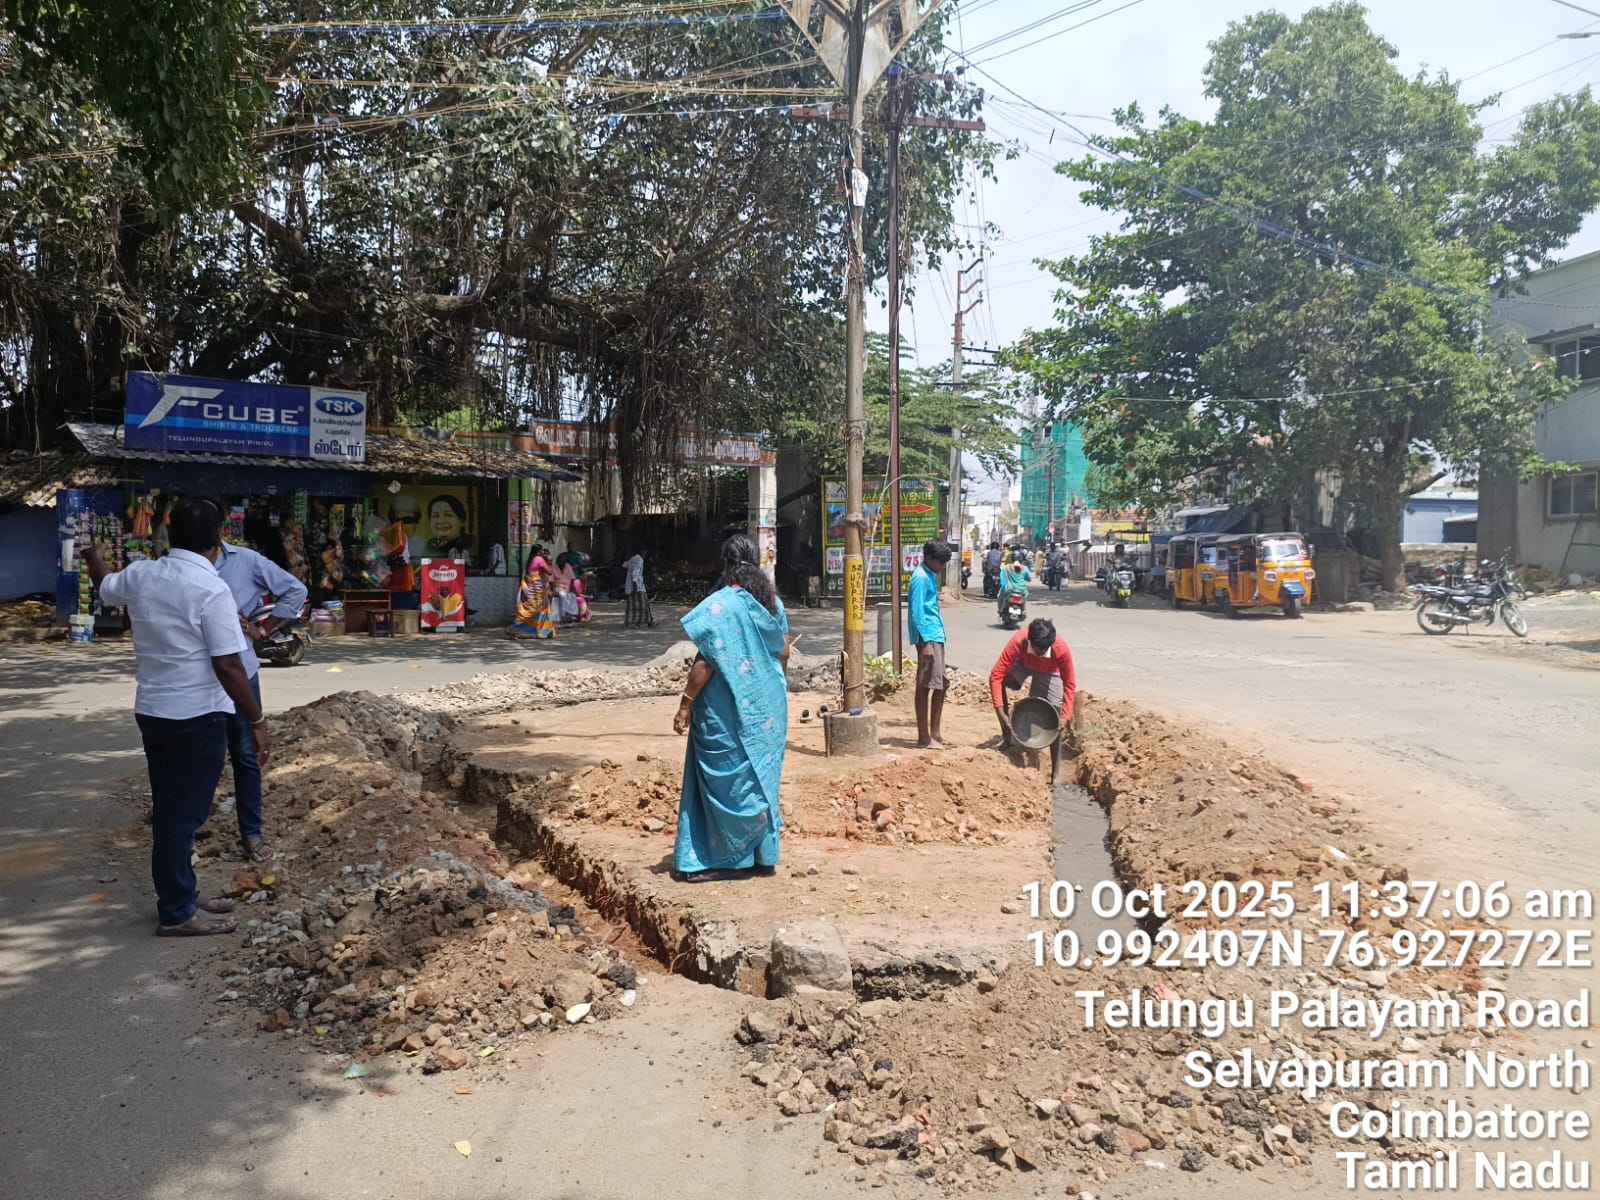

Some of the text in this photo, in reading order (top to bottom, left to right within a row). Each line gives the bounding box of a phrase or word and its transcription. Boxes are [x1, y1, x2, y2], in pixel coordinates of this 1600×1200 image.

[322, 399, 356, 414] TSK
[203, 420, 237, 430] SHIRTS
[250, 423, 299, 434] TROUSERS
[314, 438, 363, 457] ஸ்டோர்
